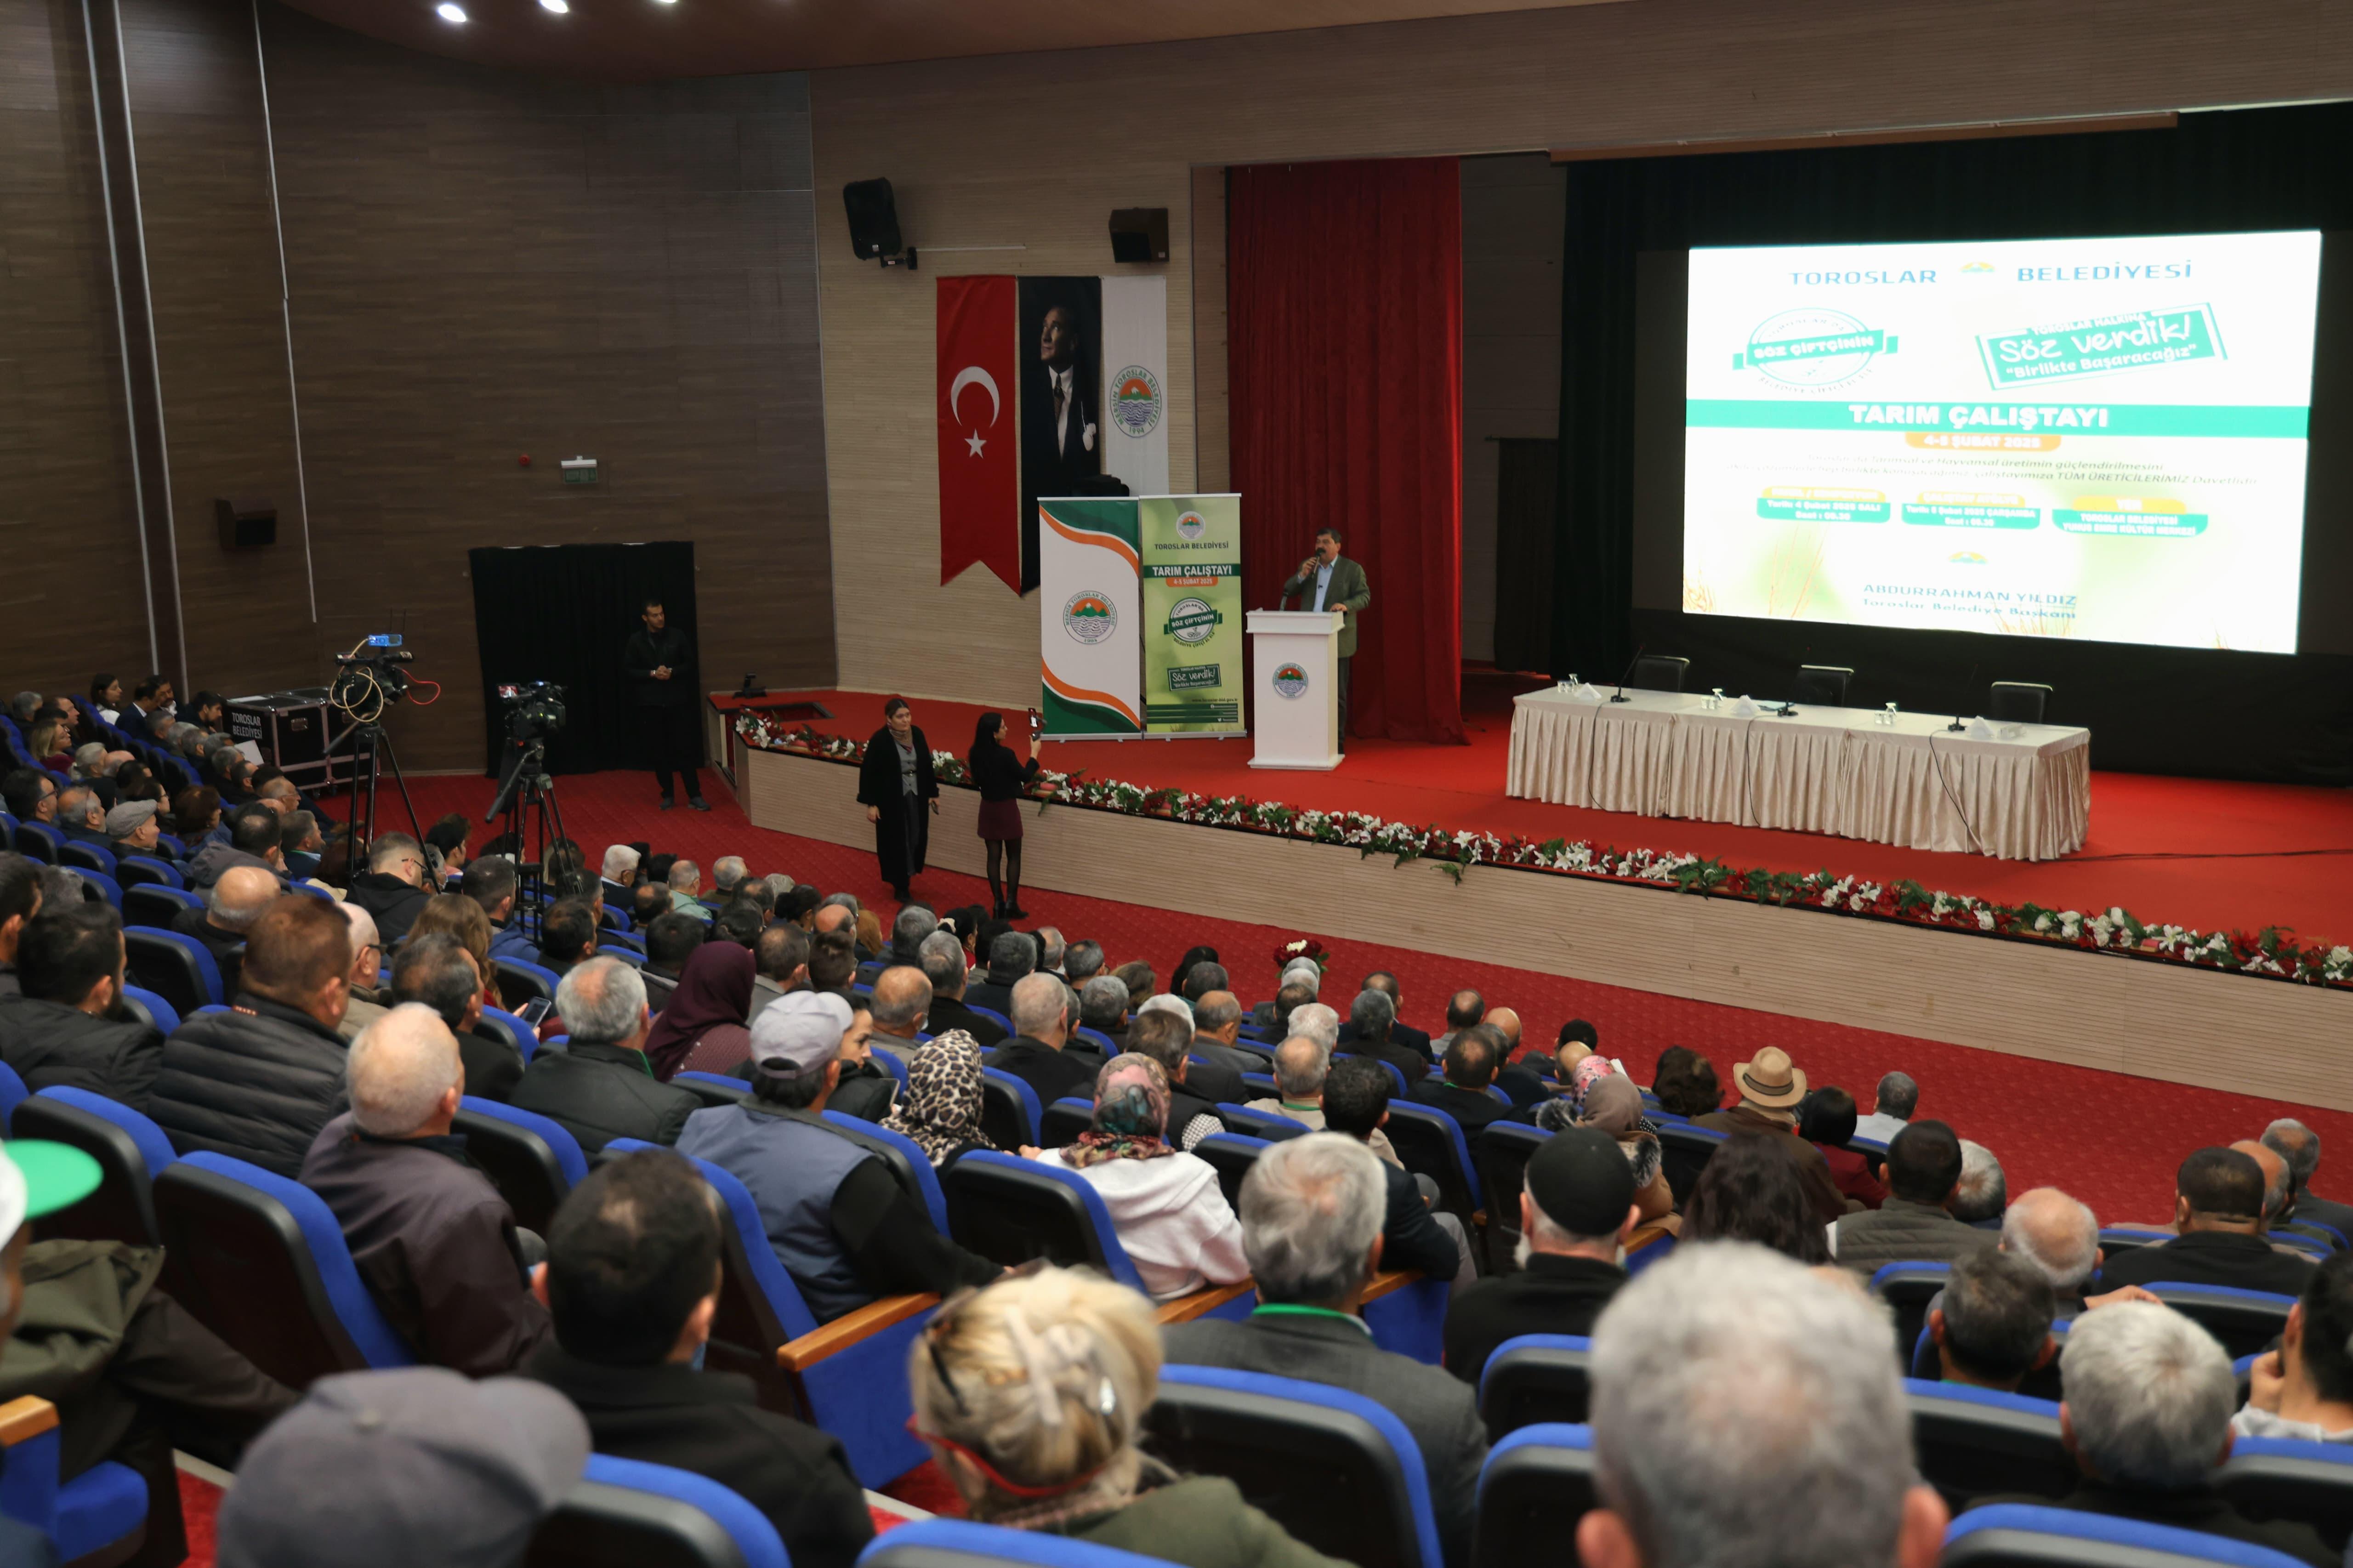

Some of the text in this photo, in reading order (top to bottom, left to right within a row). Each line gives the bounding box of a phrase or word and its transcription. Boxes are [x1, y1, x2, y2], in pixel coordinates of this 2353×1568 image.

[1789, 260, 2192, 285] TOROSLAR BELEDİYESİ
[1999, 314, 2190, 363] Söz verdik!
[1753, 336, 1874, 358] SÖZ ÇİFTÇİNİN
[1115, 369, 1148, 388] TOROSLAR
[1848, 404, 2109, 430] TARIM ÇALIŞTAYI
[2001, 460, 2052, 468] üretimin
[2055, 460, 2164, 471] güçlendirilmesini
[2057, 471, 2085, 480] TÜM
[2088, 472, 2190, 483] ÜRETİCİLERİMİZ
[1192, 540, 1229, 549] BELEDİYESİ
[1153, 565, 1232, 577] TARIM ÇALIŞTAYI
[1864, 584, 2077, 606] ABDURRAHMAN YILDIZ
[1863, 598, 2076, 619] Toroslar Belediye Başkanı
[1184, 614, 1214, 626] ÇİFTÇİNİN
[1172, 672, 1187, 682] Söz
[232, 712, 261, 727] TOROSLAR
[233, 725, 263, 739] BELEDİYESİ
